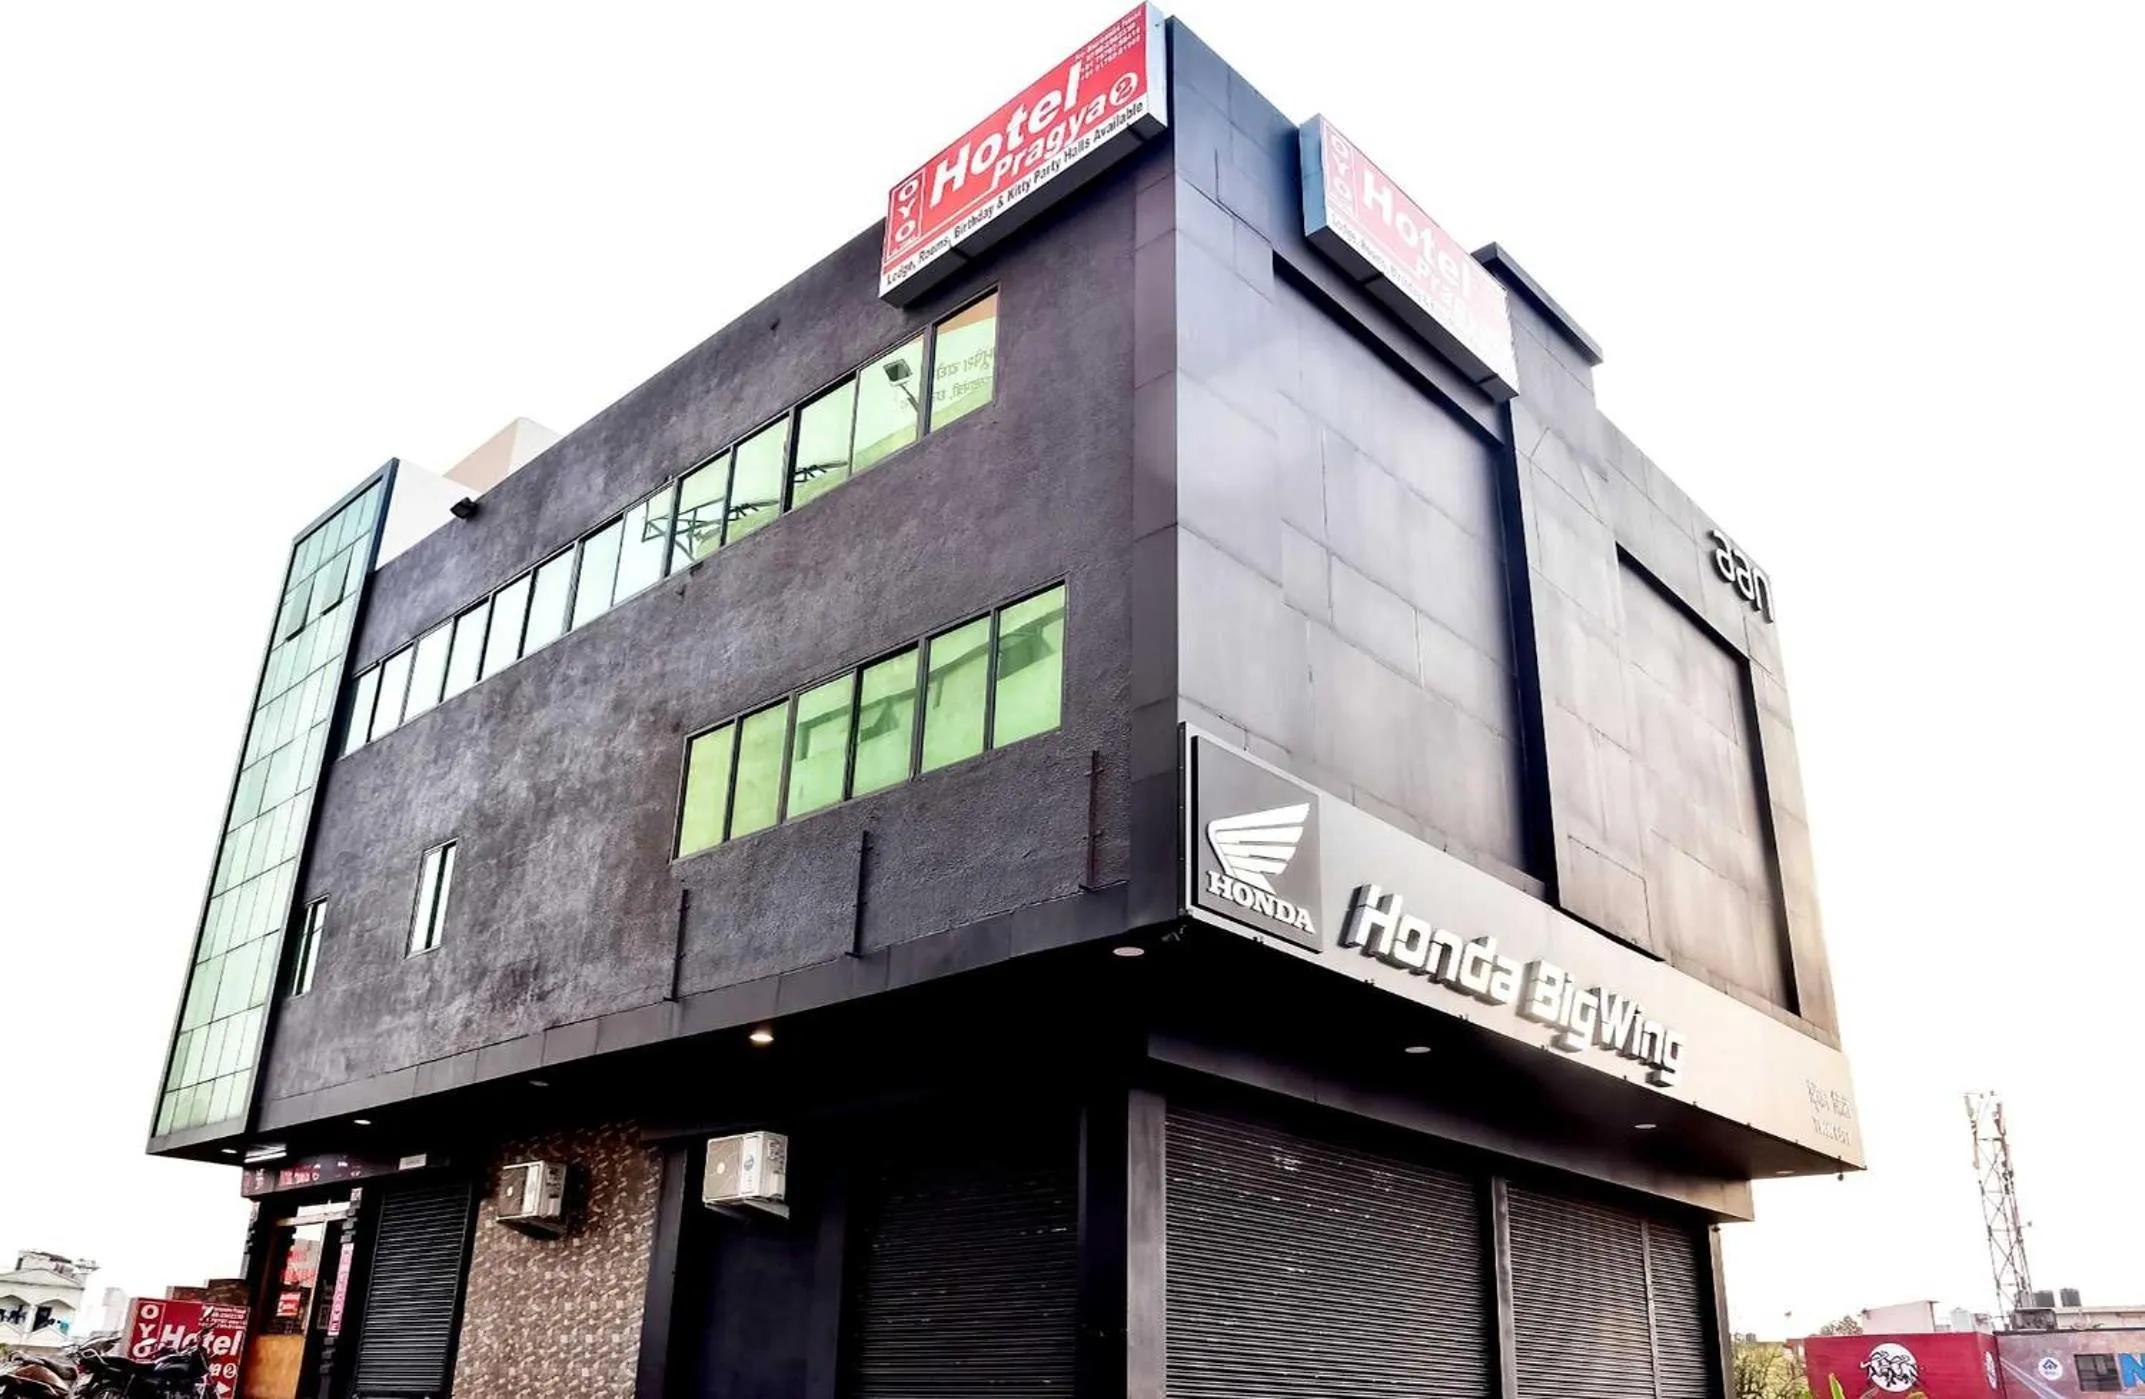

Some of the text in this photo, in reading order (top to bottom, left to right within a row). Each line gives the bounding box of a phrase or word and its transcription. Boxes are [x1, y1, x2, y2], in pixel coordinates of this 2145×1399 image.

[930, 60, 1081, 208] Hotel
[954, 205, 994, 239] Birthday
[1007, 178, 1032, 203] Kitty
[1034, 158, 1061, 184] Party
[1064, 138, 1090, 163] Halls
[1093, 101, 1143, 143] Available
[990, 93, 1107, 190] Pragya
[1331, 134, 1352, 199] OYO
[895, 179, 919, 242] OYO
[1362, 170, 1471, 300] Hotel
[1206, 870, 1316, 934] HONDA
[1340, 883, 1686, 1087] Honda BigWing
[132, 1304, 160, 1358] OYO
[159, 1323, 243, 1357] Hotel
